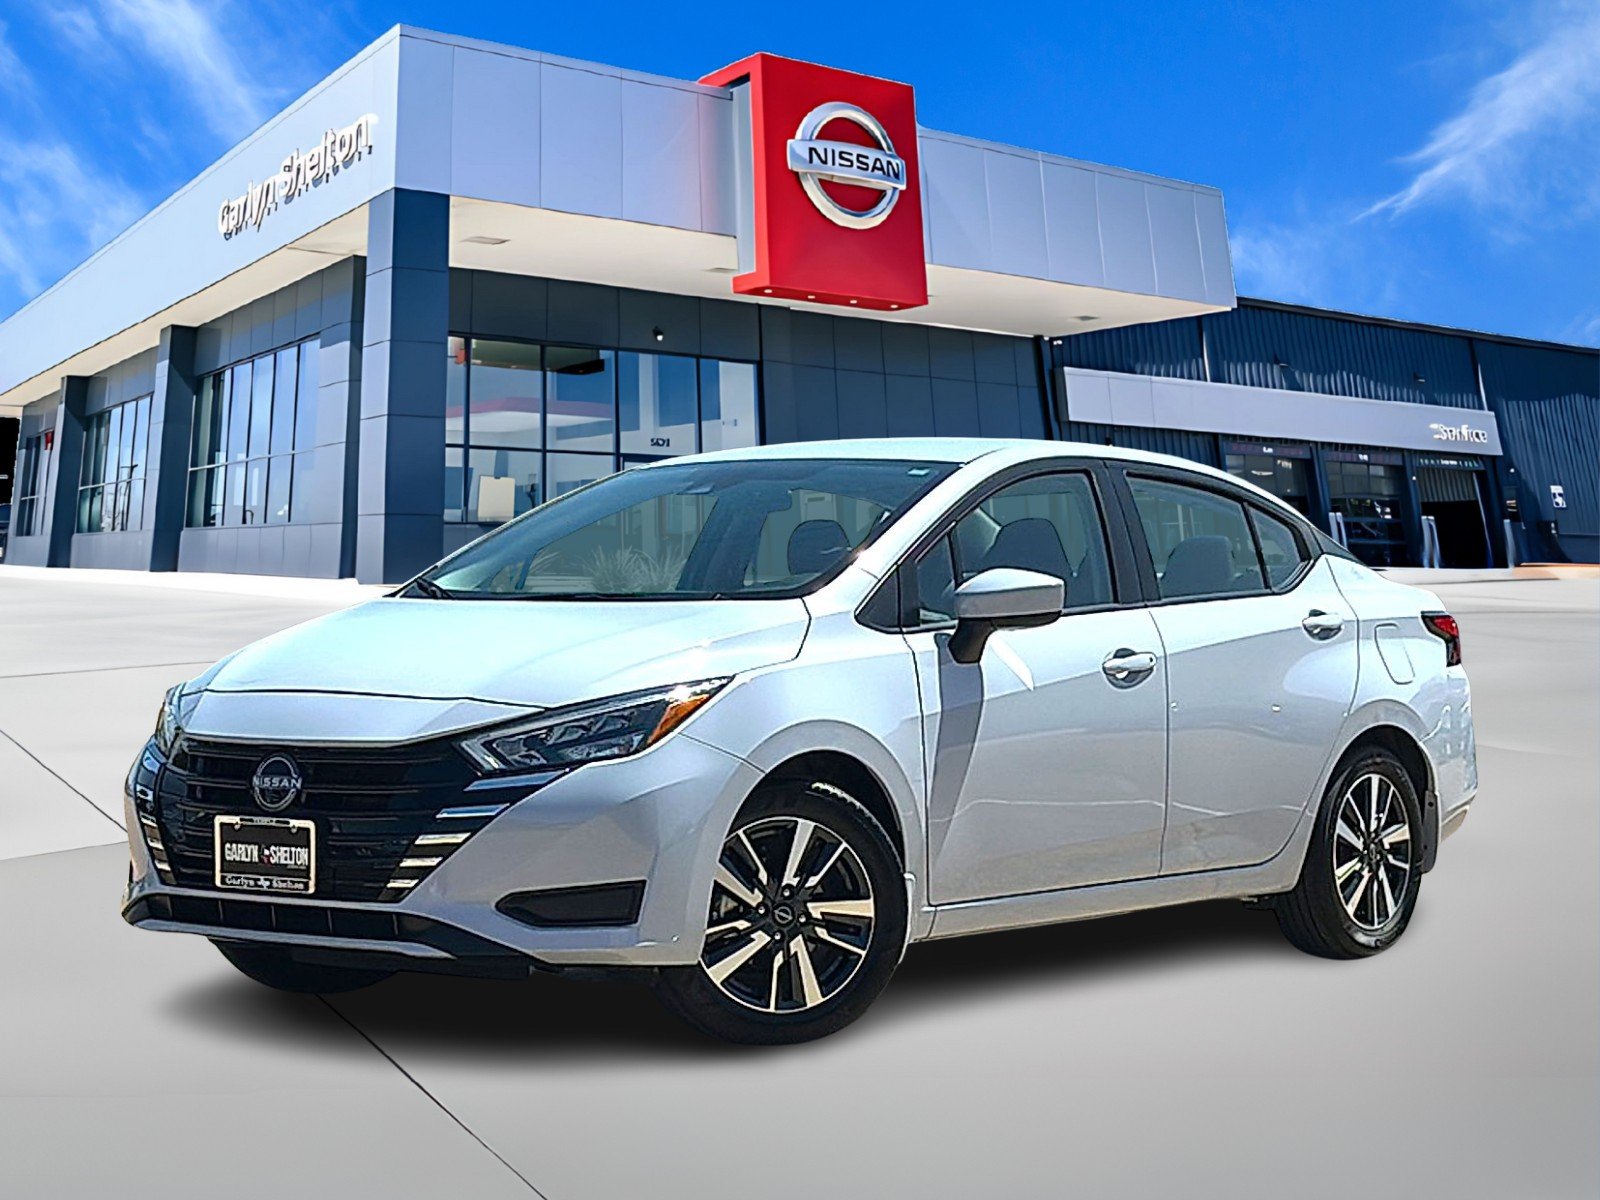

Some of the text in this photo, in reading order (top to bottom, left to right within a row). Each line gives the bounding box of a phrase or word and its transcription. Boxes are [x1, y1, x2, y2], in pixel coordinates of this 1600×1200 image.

[278, 116, 373, 203] Shelton
[808, 146, 900, 180] NISSAN
[253, 775, 302, 789] NISSAN
[224, 842, 309, 866] GARLYN SHELTON
